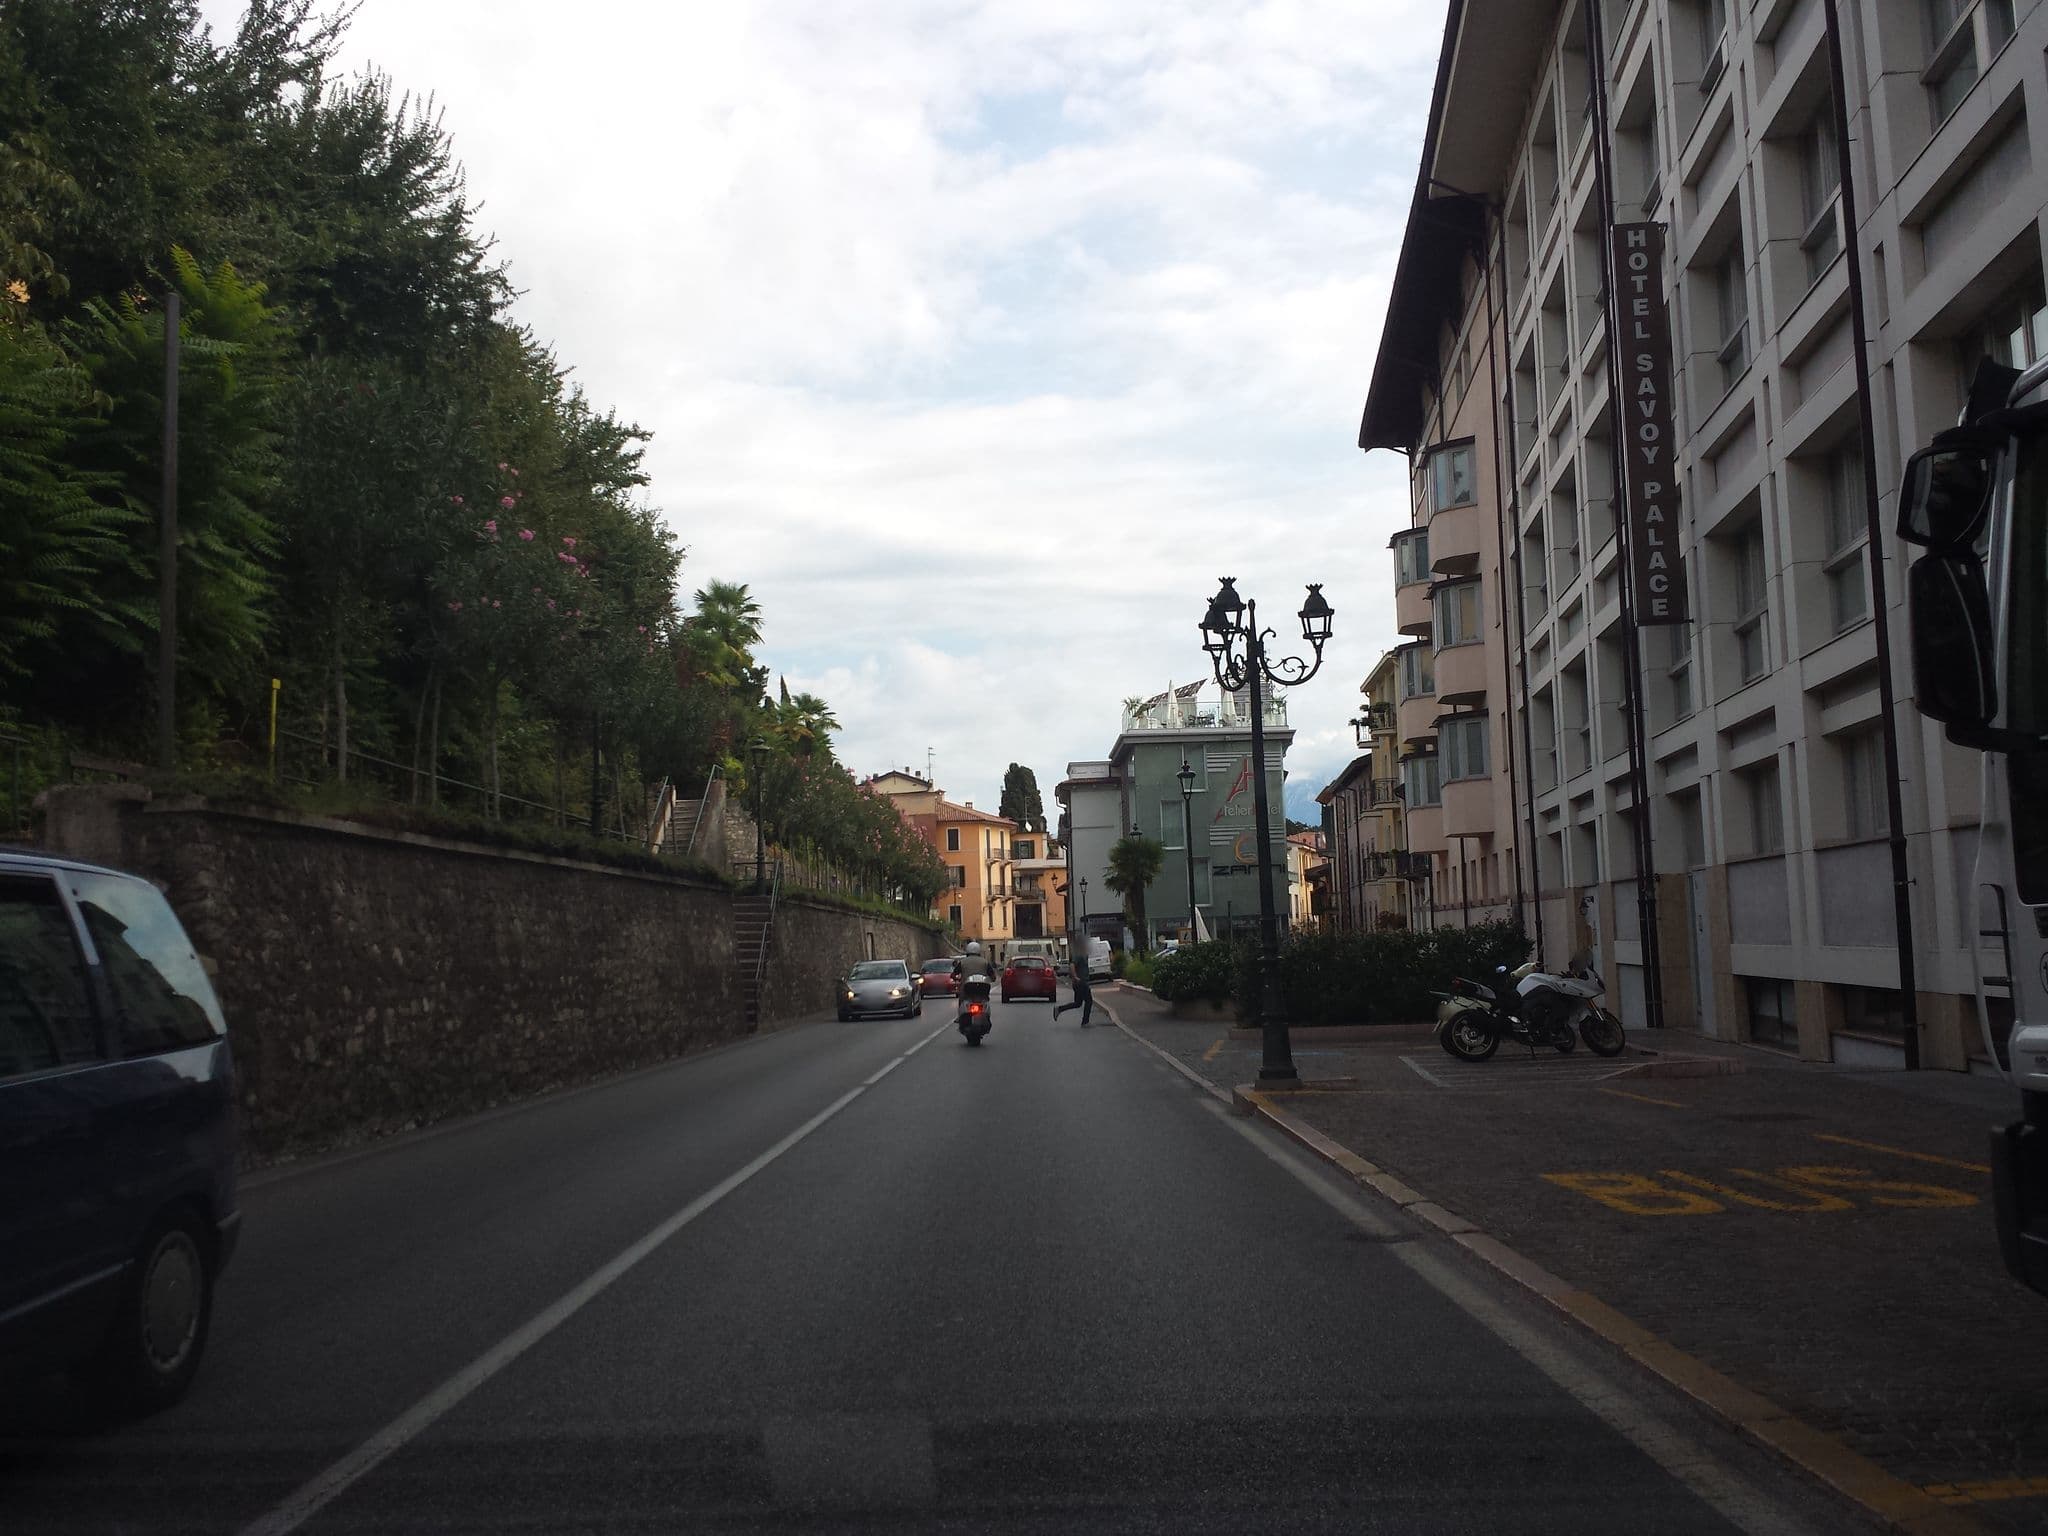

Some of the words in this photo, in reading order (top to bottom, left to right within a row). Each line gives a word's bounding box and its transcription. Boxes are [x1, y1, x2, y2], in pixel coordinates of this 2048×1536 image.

[1628, 229, 1651, 340] HOTEL
[1636, 353, 1660, 464] SAVOY
[1643, 481, 1669, 617] PALACE
[1538, 1165, 1979, 1215] BUS
